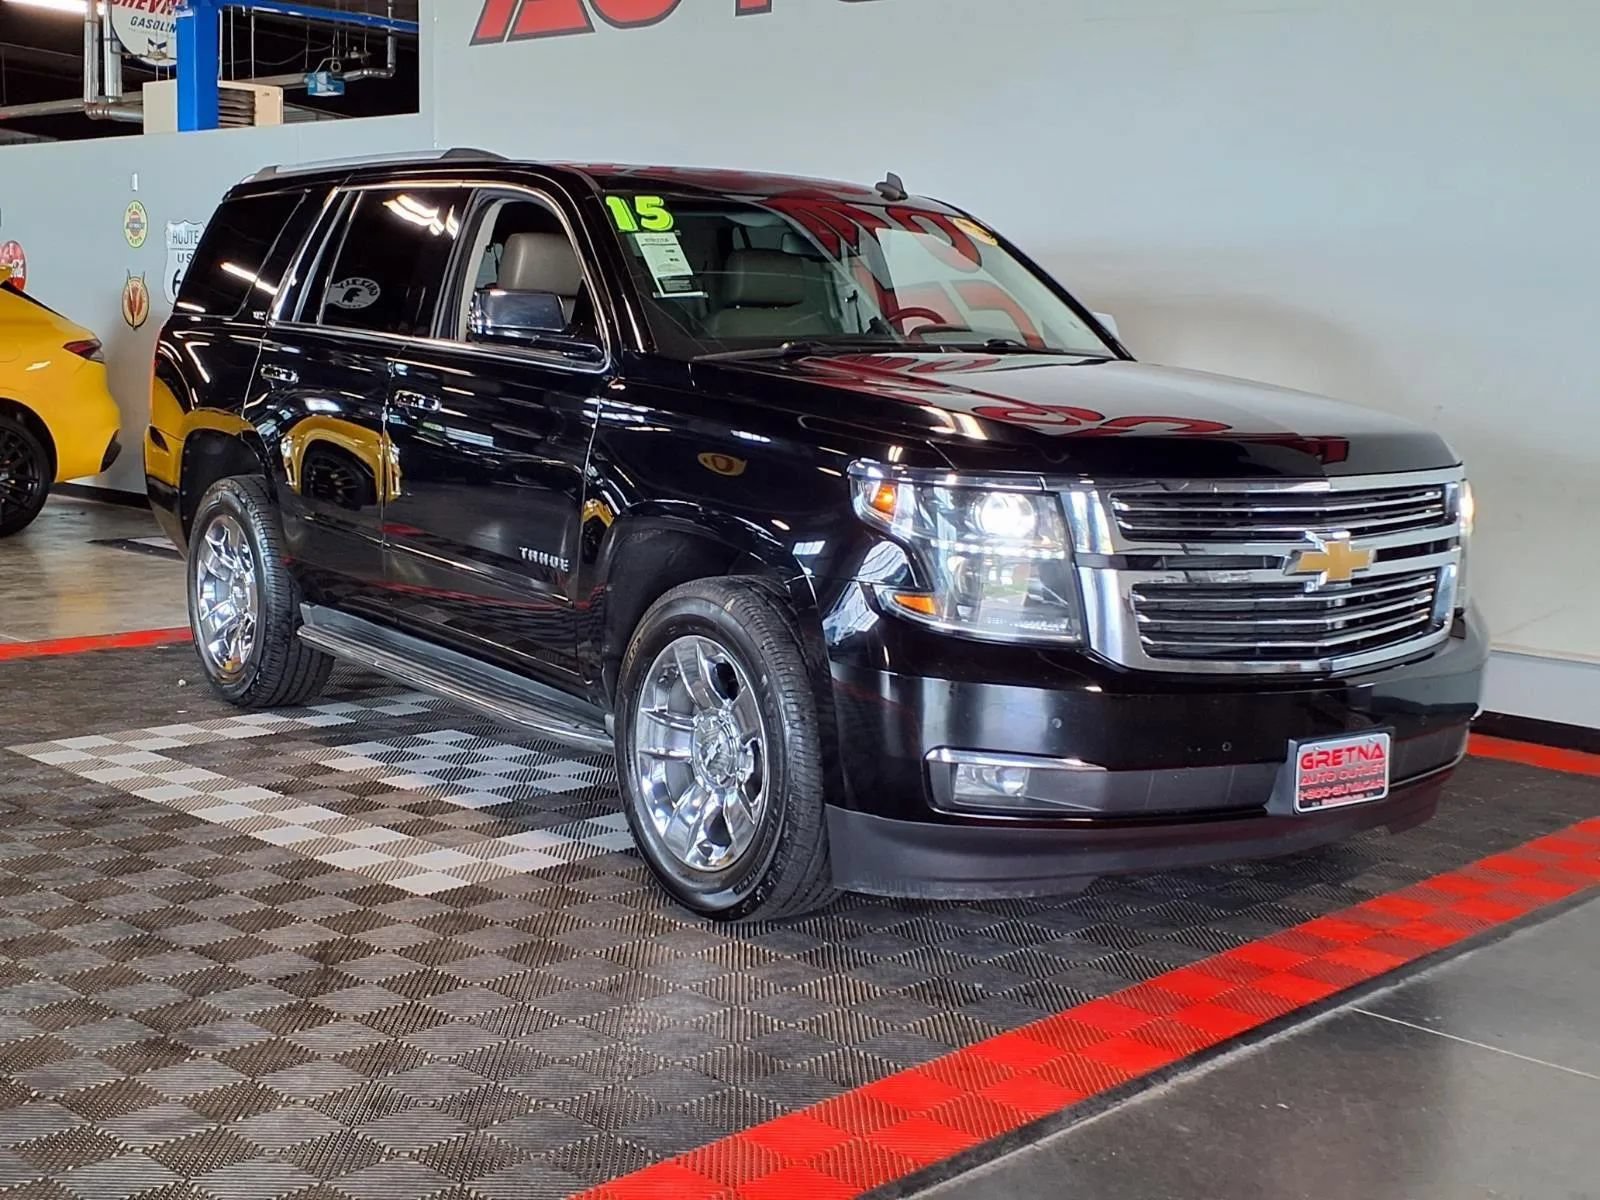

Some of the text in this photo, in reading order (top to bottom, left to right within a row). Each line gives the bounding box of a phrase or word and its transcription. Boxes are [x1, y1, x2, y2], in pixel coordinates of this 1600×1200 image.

[130, 16, 176, 33] GASOLIN
[606, 196, 673, 231] 15
[173, 230, 199, 245] ROUTE
[177, 253, 193, 263] US
[519, 546, 569, 573] TAHOE
[1301, 744, 1385, 770] GRETNA
[1300, 763, 1385, 786] AUTO OUTLET
